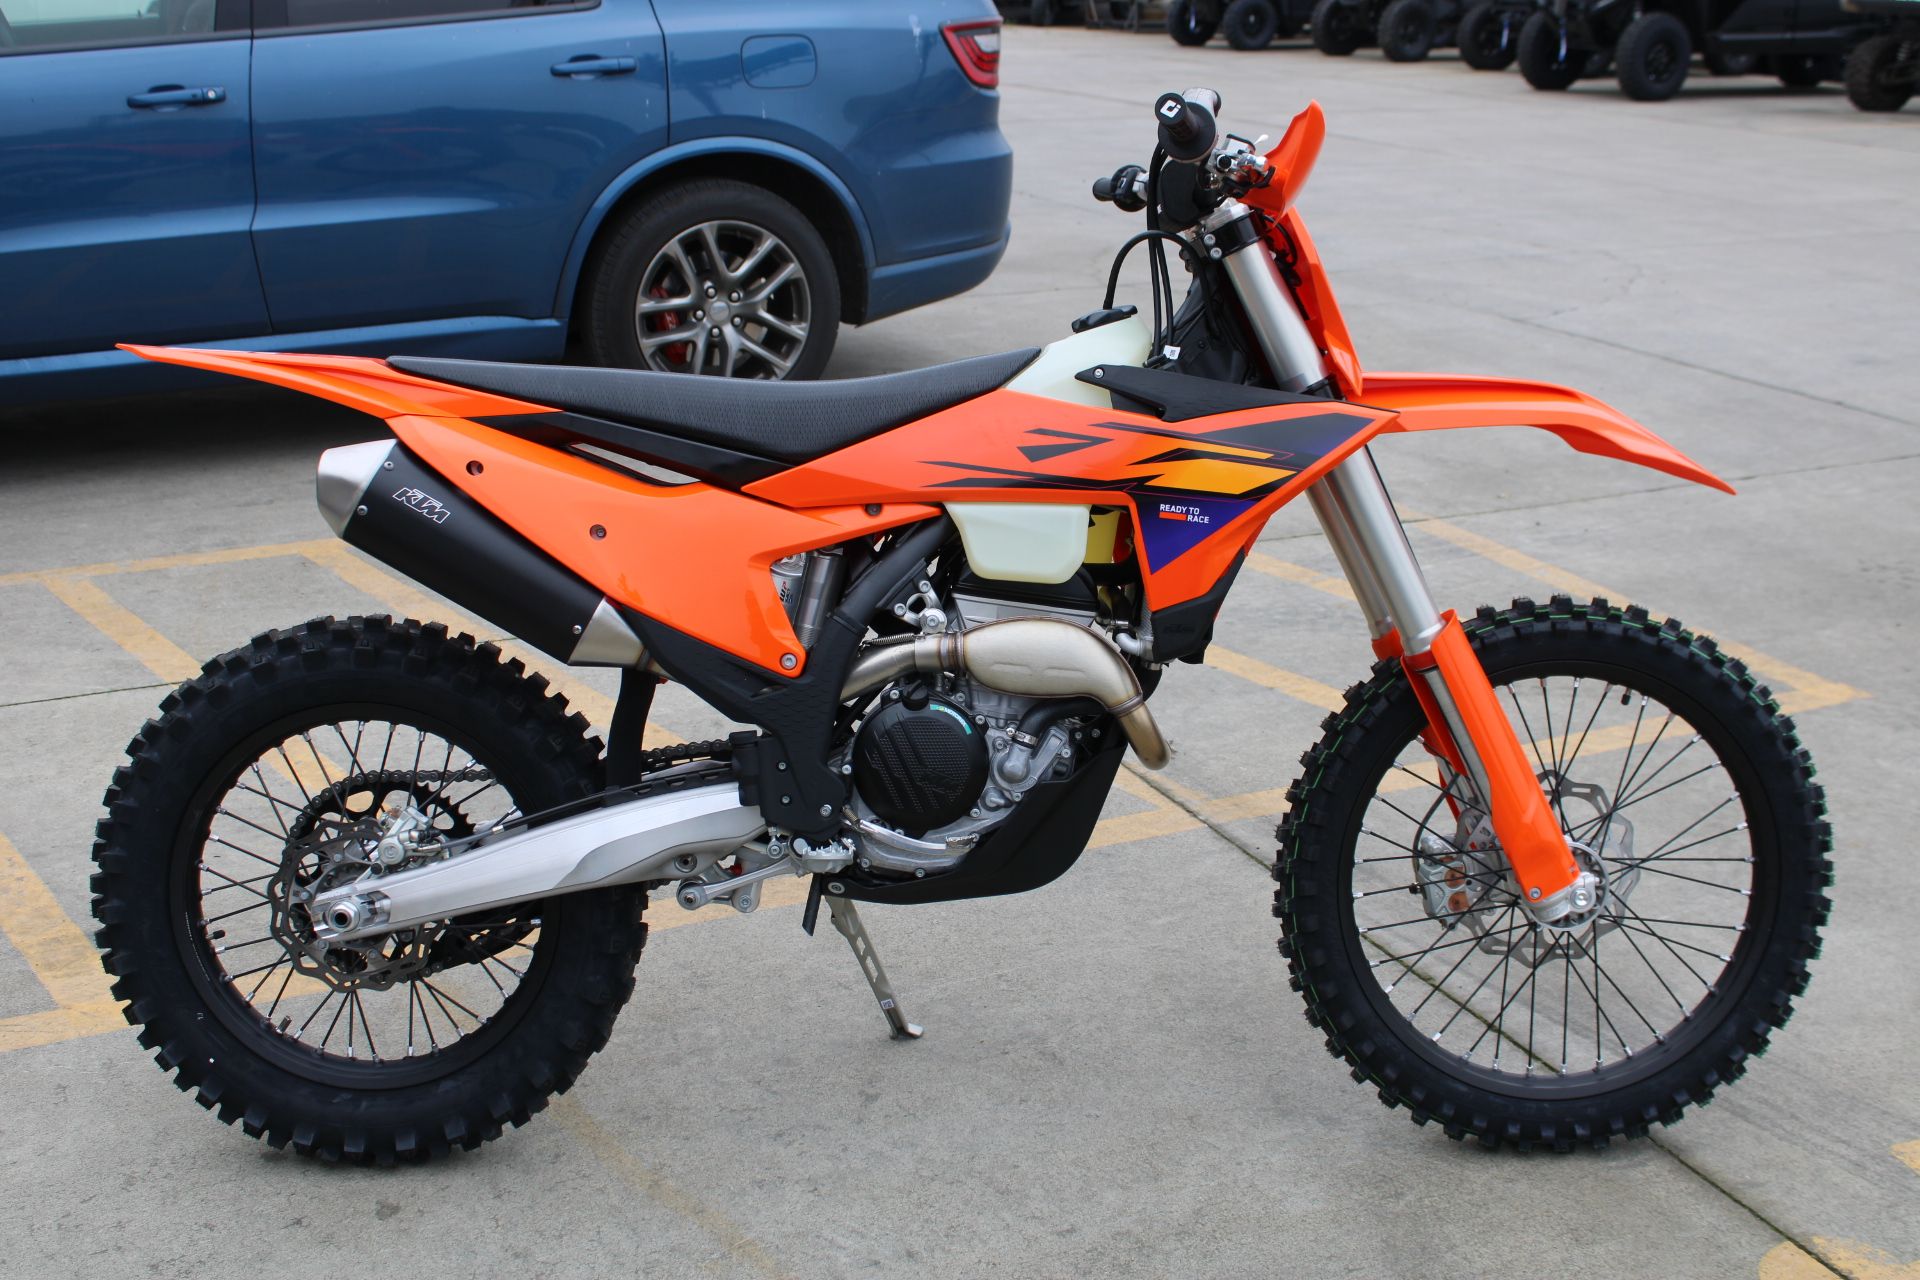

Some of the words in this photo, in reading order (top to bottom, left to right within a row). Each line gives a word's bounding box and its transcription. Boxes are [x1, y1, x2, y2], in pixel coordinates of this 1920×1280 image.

[392, 487, 451, 524] KTM
[1160, 503, 1188, 514] READY
[1188, 507, 1200, 515] TO
[1187, 515, 1210, 524] RACE
